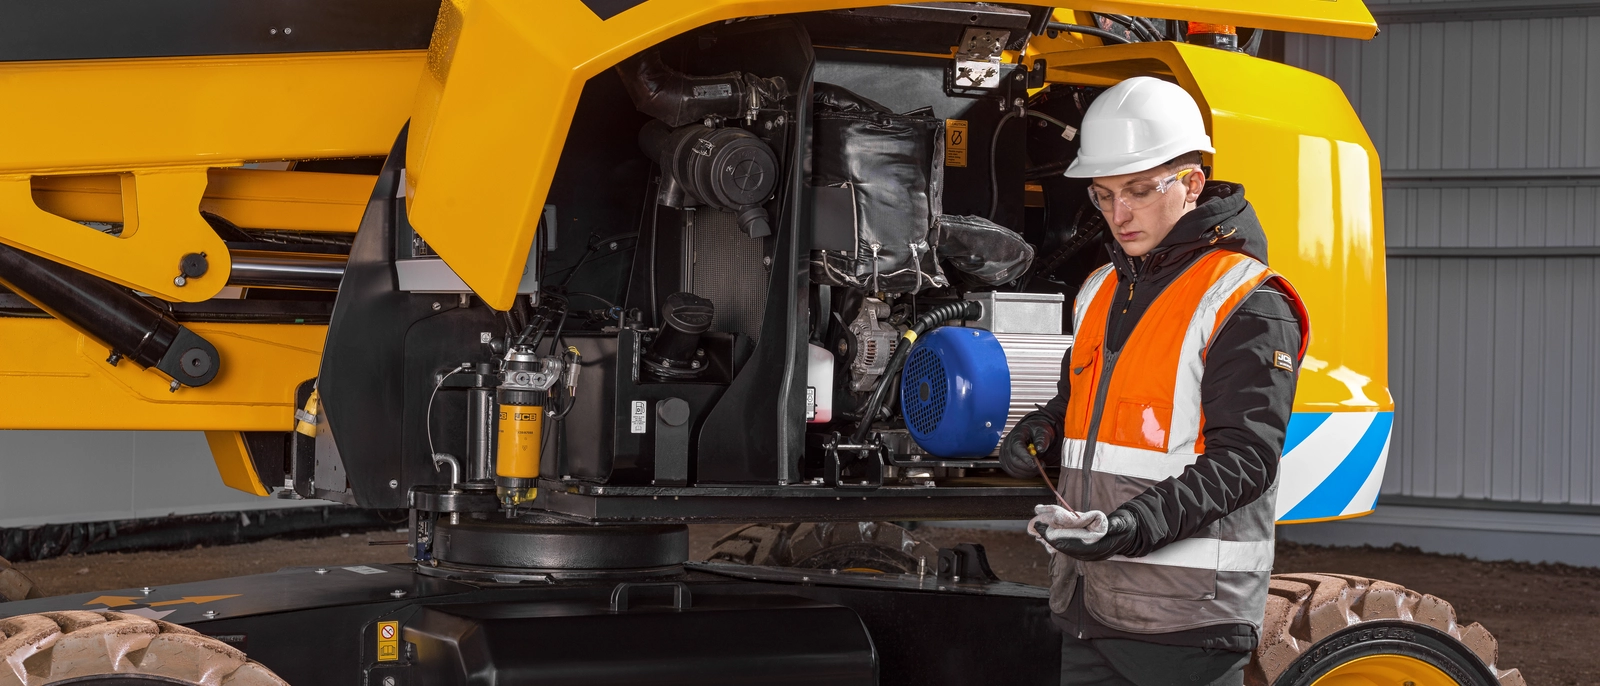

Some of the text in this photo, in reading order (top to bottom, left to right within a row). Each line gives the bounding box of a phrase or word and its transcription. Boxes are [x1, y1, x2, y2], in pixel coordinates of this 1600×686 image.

[1278, 354, 1292, 365] JCB
[515, 413, 537, 421] JCB
[1299, 627, 1413, 673] OUTRIGGER
